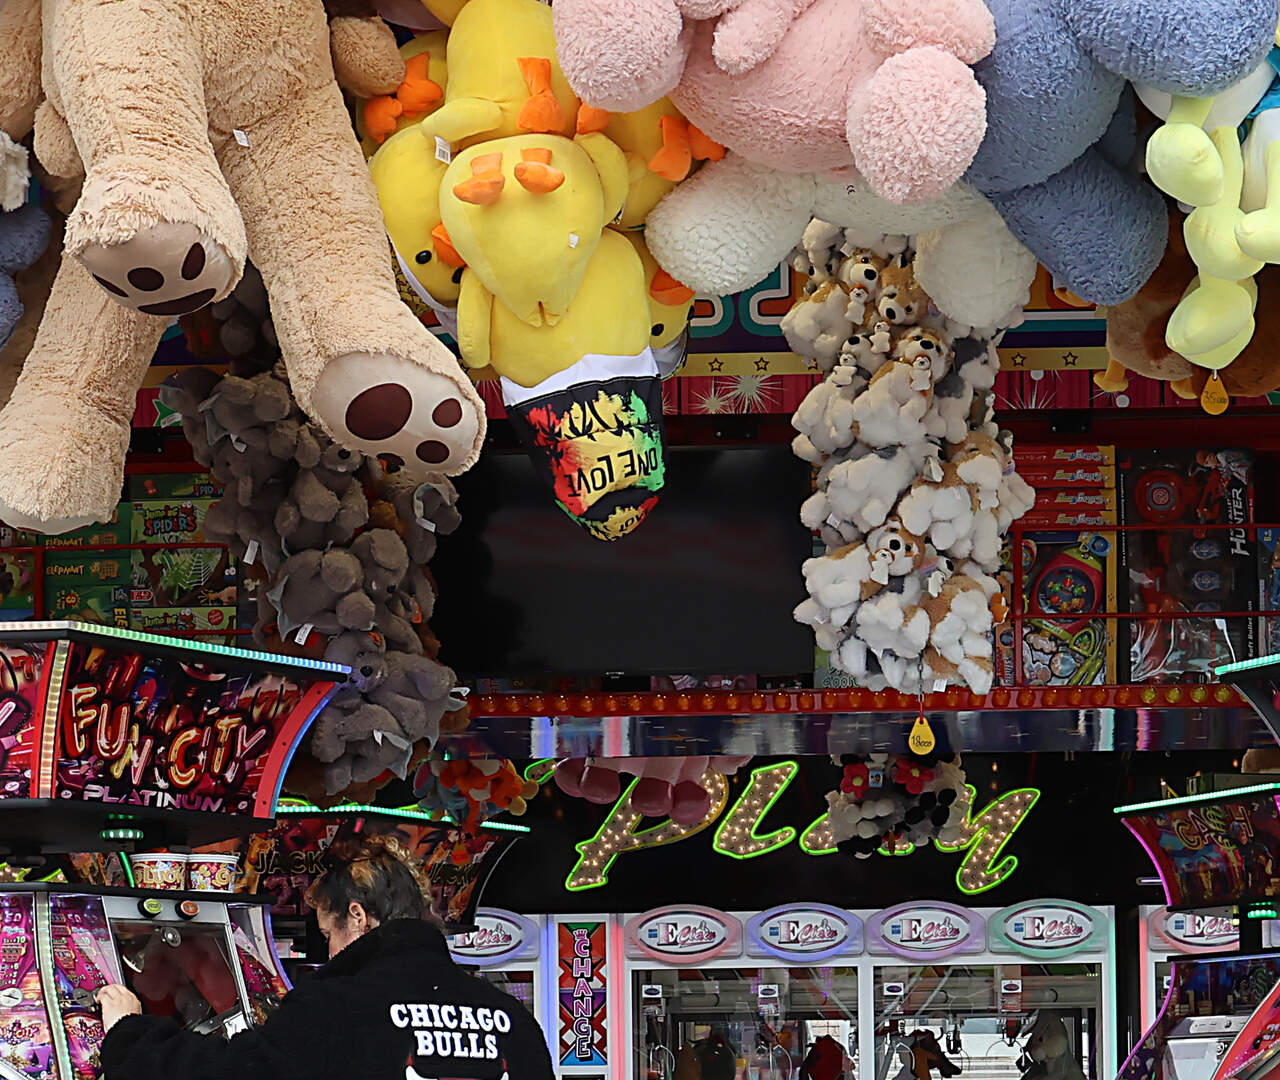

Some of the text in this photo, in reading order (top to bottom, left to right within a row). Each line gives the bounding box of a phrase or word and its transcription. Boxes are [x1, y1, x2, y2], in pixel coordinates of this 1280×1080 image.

[69, 683, 272, 787] FUN CITY
[82, 784, 223, 812] PLATINUM
[572, 938, 595, 1059] CHANGE
[390, 1002, 512, 1034] CHICAGO
[414, 1029, 500, 1061] BULLS
